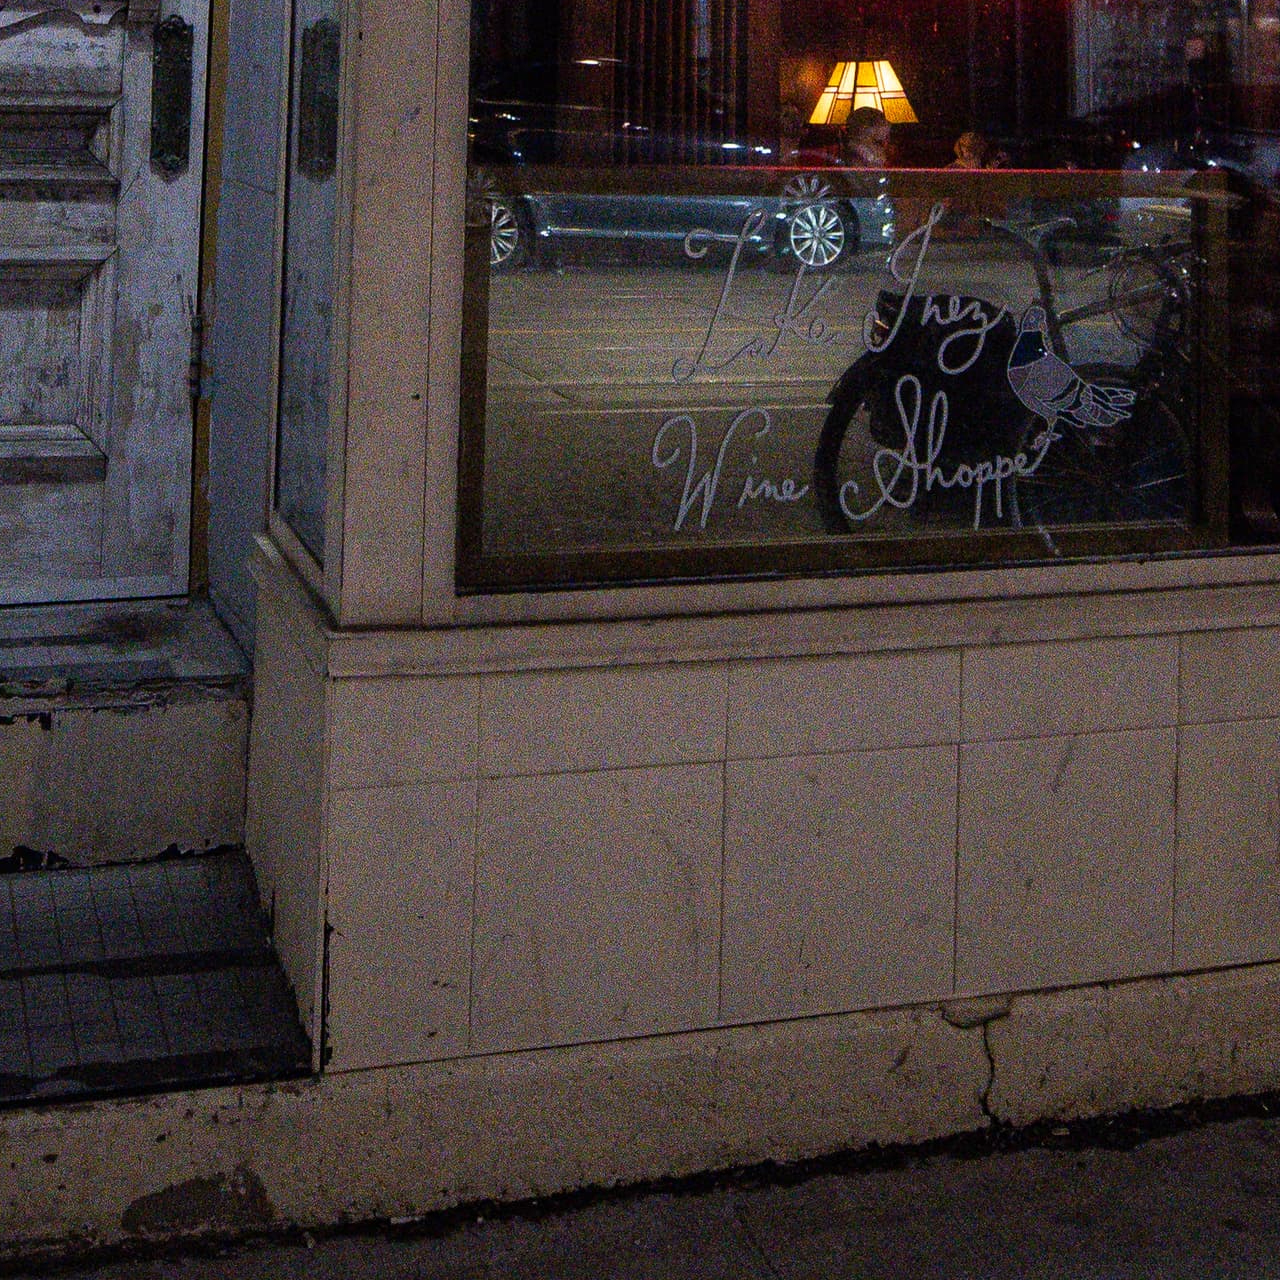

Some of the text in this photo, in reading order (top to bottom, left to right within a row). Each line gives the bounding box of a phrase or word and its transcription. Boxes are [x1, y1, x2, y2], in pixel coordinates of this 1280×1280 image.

[862, 201, 1008, 375] Inez
[651, 374, 1034, 532] Wine Shoppe
